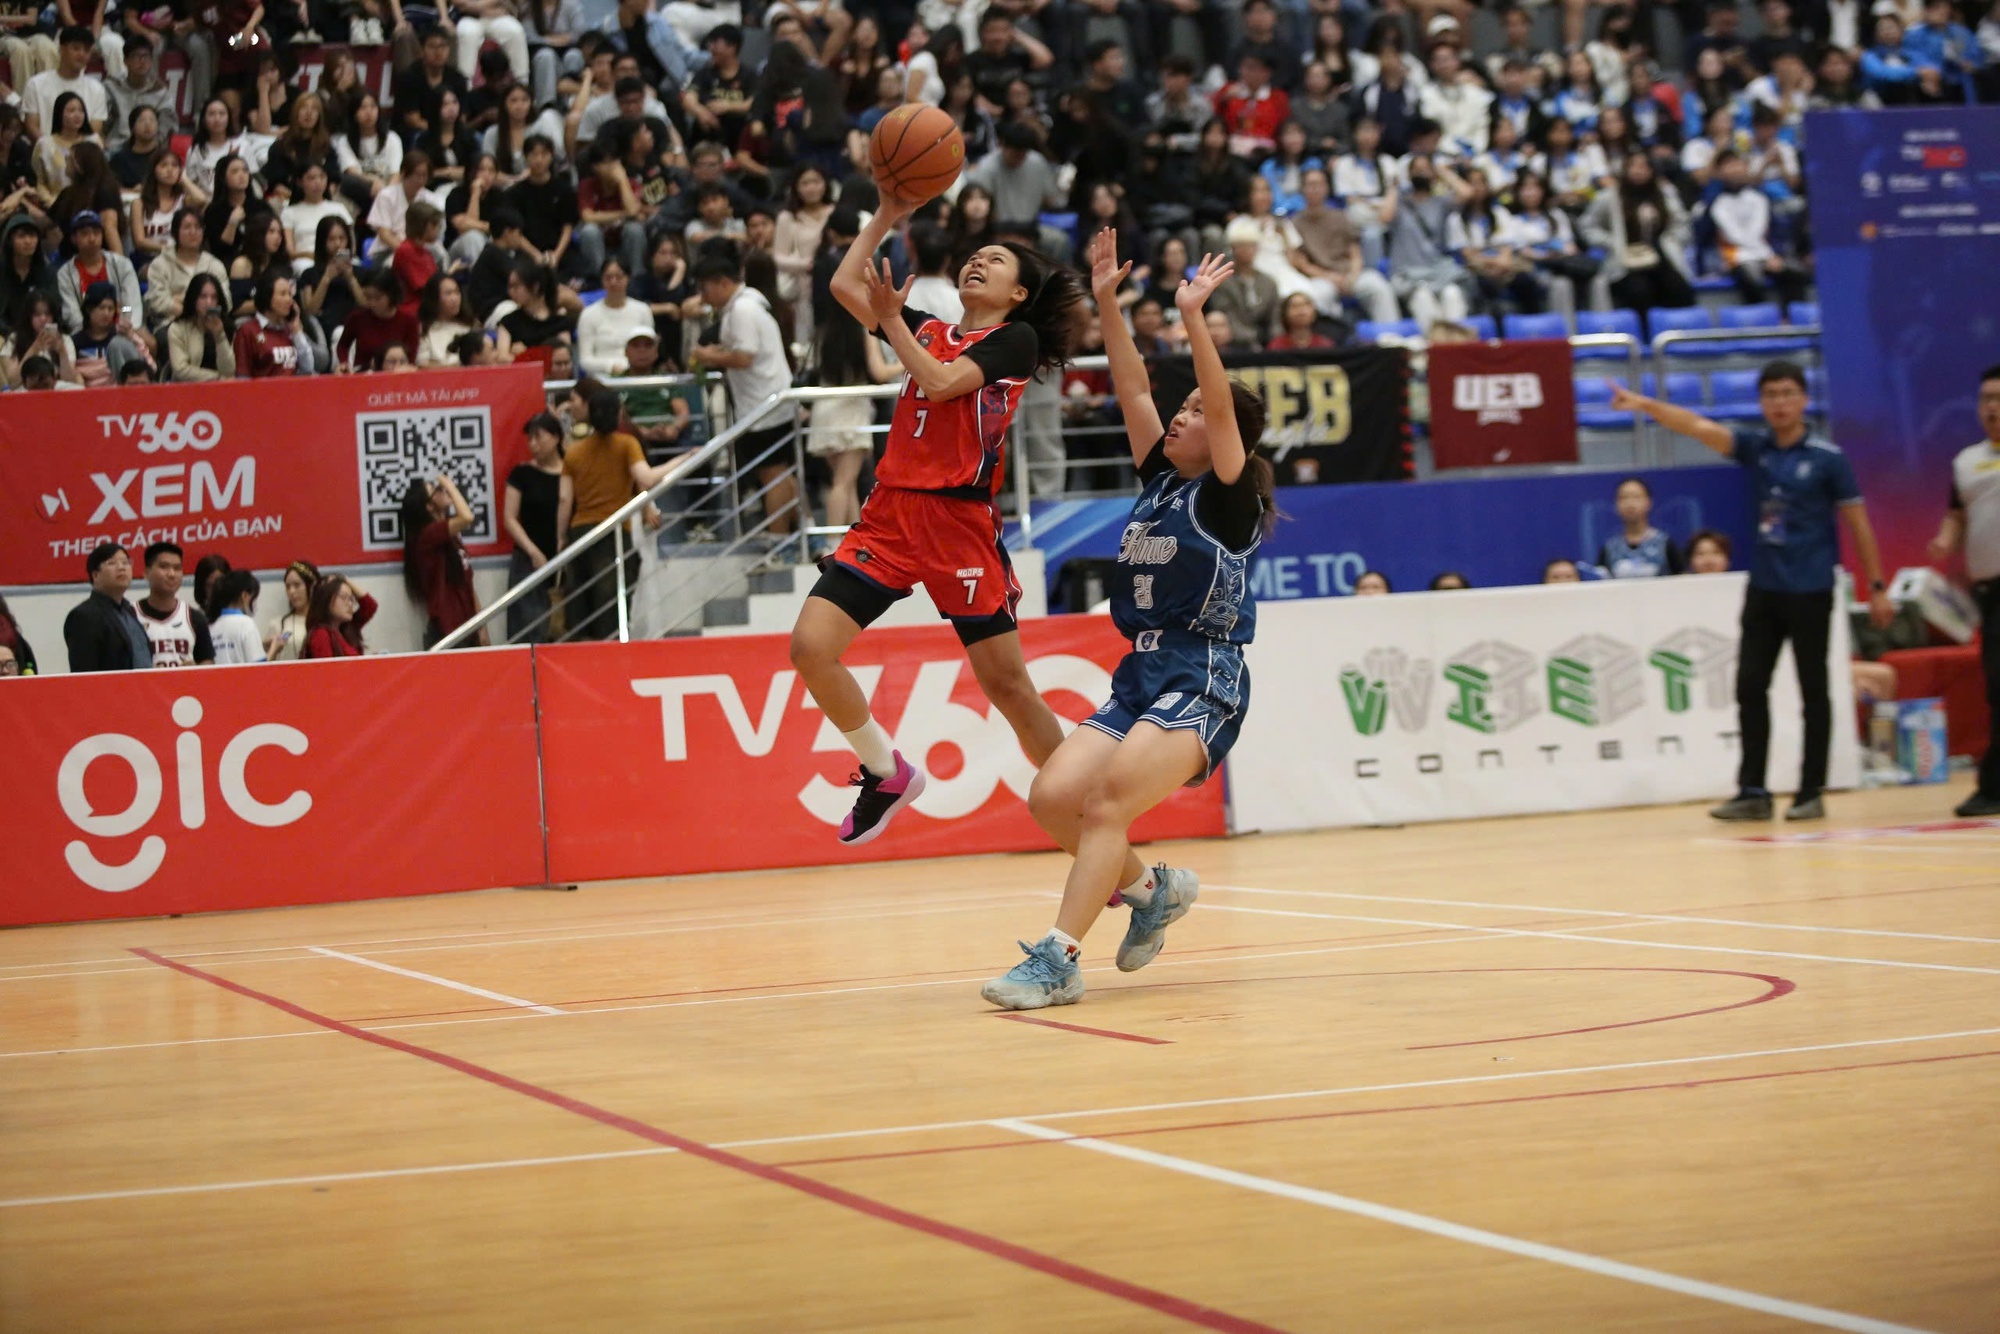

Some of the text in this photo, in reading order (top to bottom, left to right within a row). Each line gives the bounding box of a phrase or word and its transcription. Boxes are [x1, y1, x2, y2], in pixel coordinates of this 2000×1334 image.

[1453, 371, 1544, 411] UEB
[97, 410, 222, 453] TV360
[913, 410, 928, 437] 7
[87, 455, 256, 525] XEM
[182, 518, 228, 543] CỦA
[233, 514, 284, 539] BẠN
[956, 567, 985, 578] HOOPS
[962, 579, 978, 605] 7
[57, 696, 312, 893] gic
